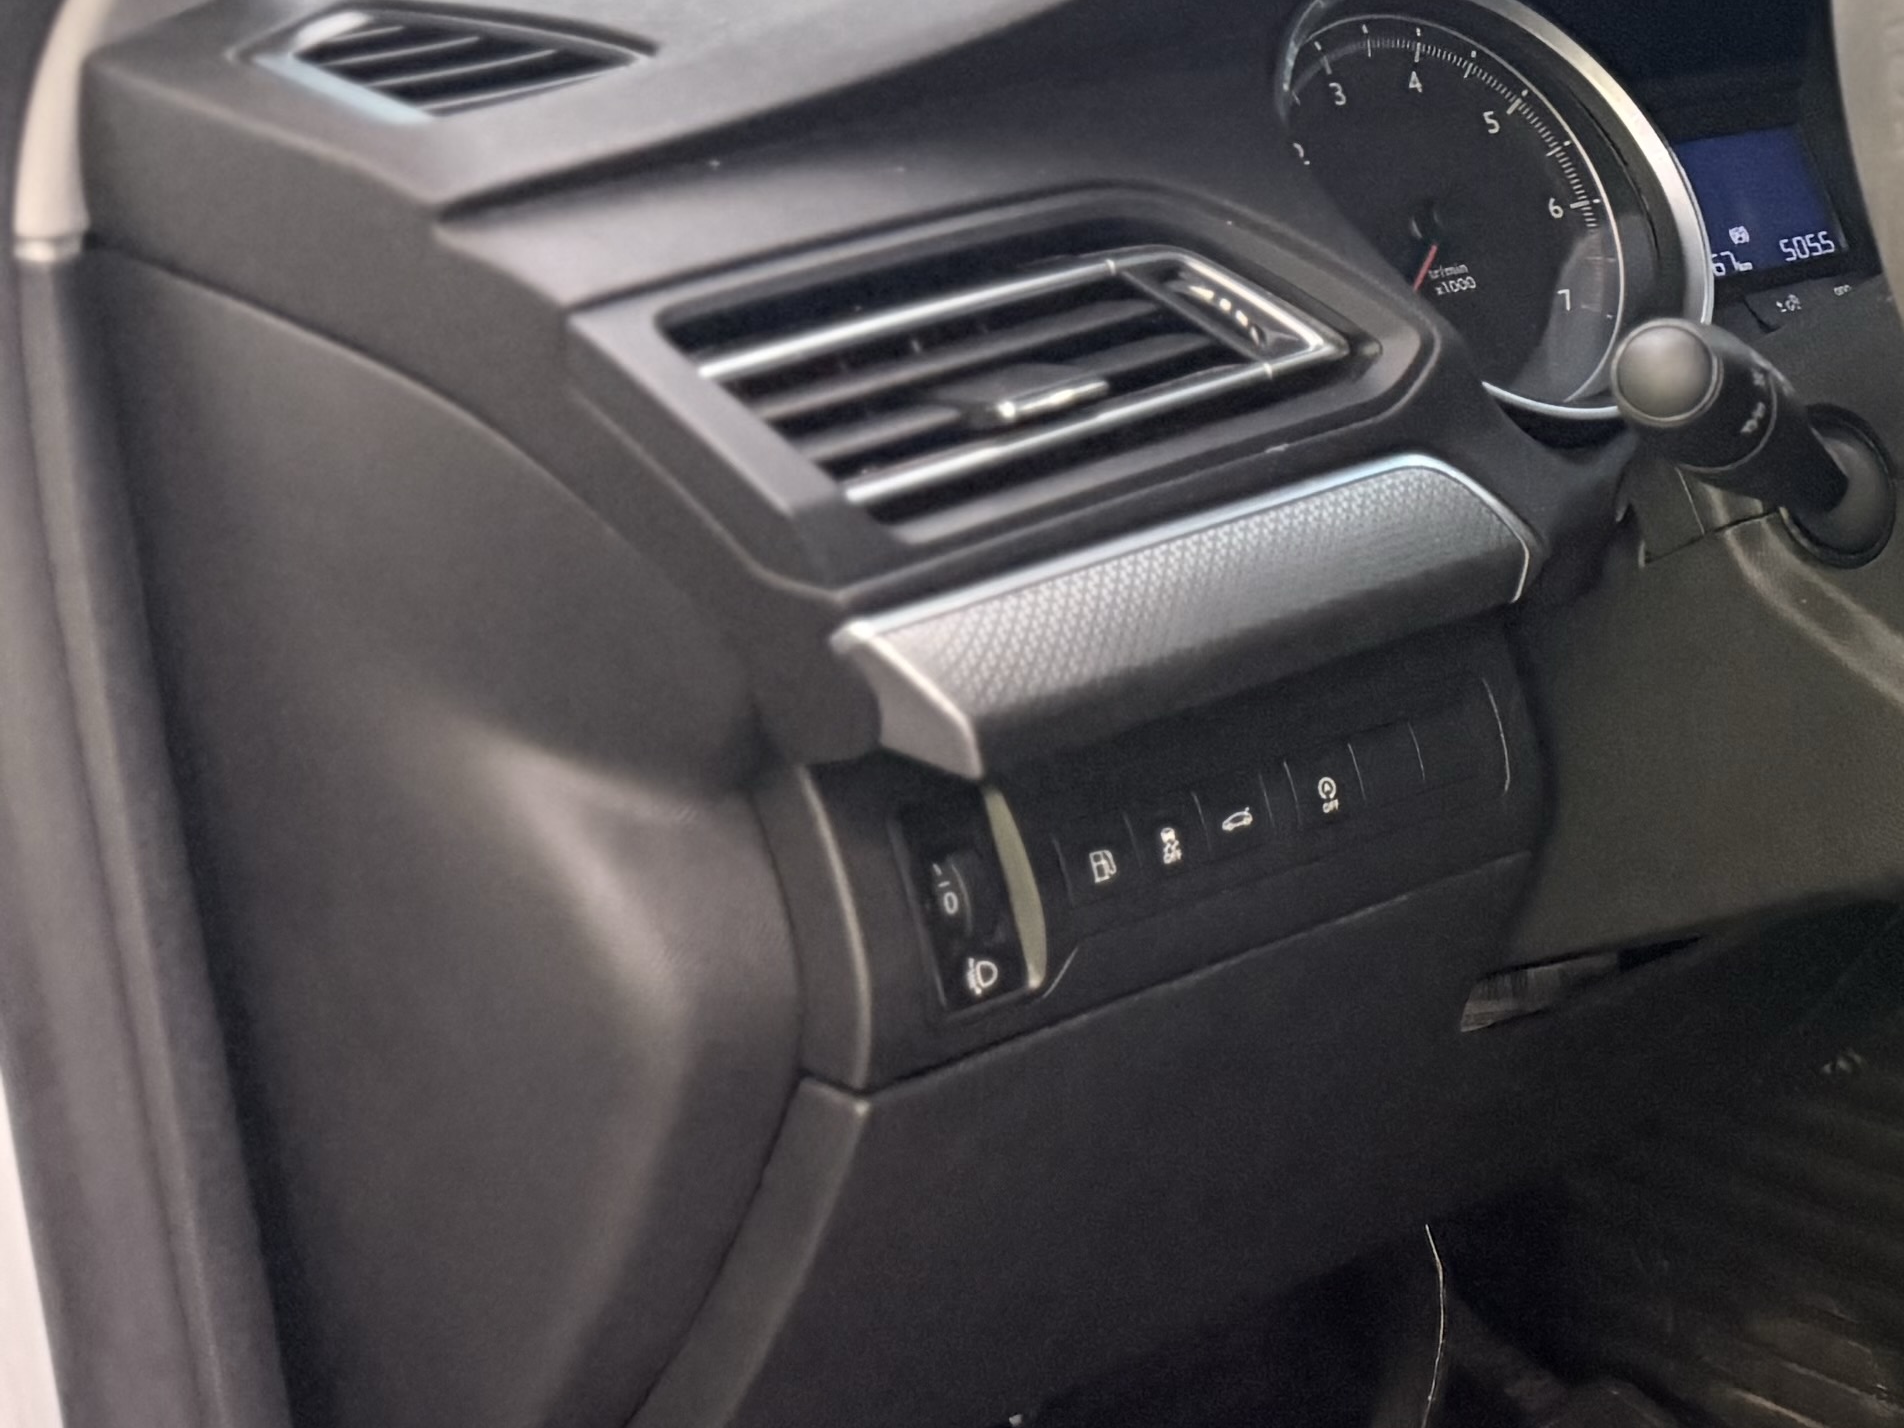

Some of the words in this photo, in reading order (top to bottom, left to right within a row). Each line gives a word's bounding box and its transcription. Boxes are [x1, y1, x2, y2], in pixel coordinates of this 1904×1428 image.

[1408, 71, 1423, 93] 4
[1329, 82, 1346, 105] 3
[1483, 110, 1500, 134] 5
[1549, 197, 1564, 219] 6
[1557, 289, 1571, 311] 7
